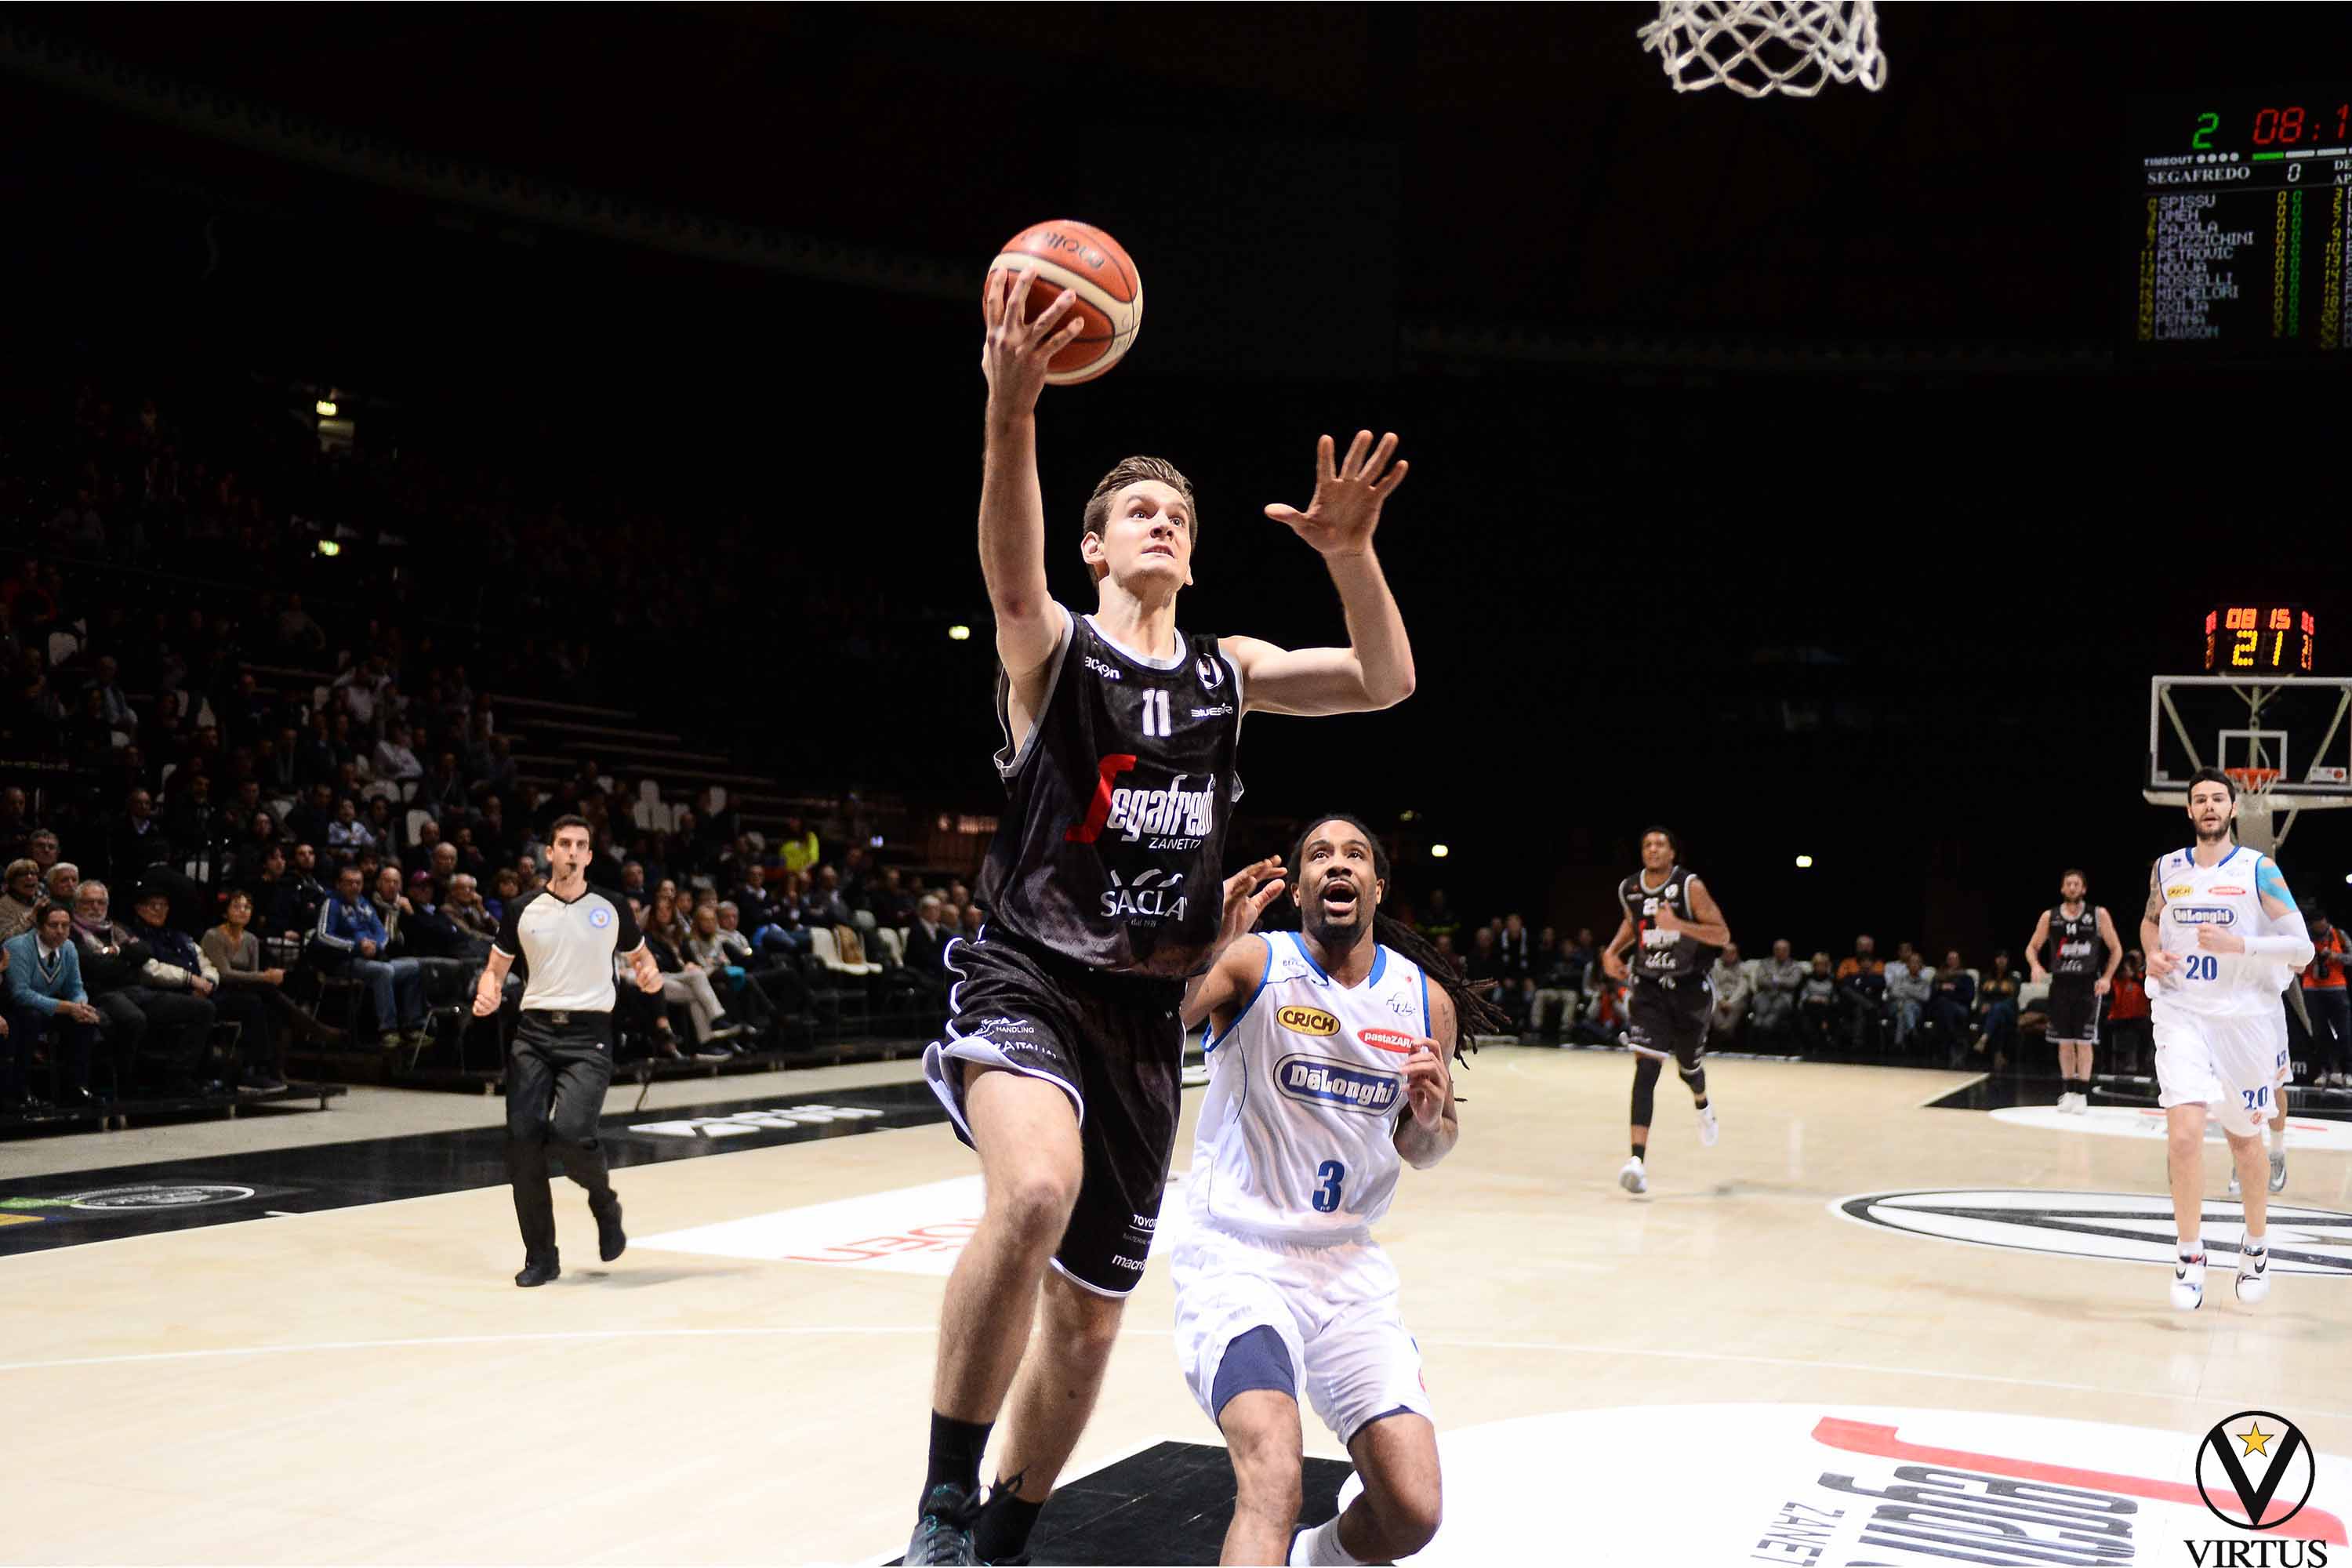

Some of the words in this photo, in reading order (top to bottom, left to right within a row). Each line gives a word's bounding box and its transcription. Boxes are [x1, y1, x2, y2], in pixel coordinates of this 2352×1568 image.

[2192, 112, 2220, 149] 2
[2144, 155, 2193, 166] TIMEOUT
[2147, 166, 2251, 184] SEGAFREDO
[2287, 163, 2301, 182] 0
[2158, 194, 2216, 209] SPISSU
[2158, 209, 2198, 222] UMEH
[2158, 220, 2218, 234] PAJOLA
[2158, 232, 2253, 248] SPIZZICHINI
[2226, 608, 2257, 629] 08
[2270, 608, 2291, 629] 15
[2232, 630, 2283, 666] 21
[1142, 688, 1172, 737] 11
[1148, 837, 1202, 851] ZANETTI
[2185, 954, 2218, 980] 20
[1283, 1009, 1335, 1033] CRICH
[2241, 1085, 2268, 1110] 20
[1312, 1160, 1345, 1213] 3
